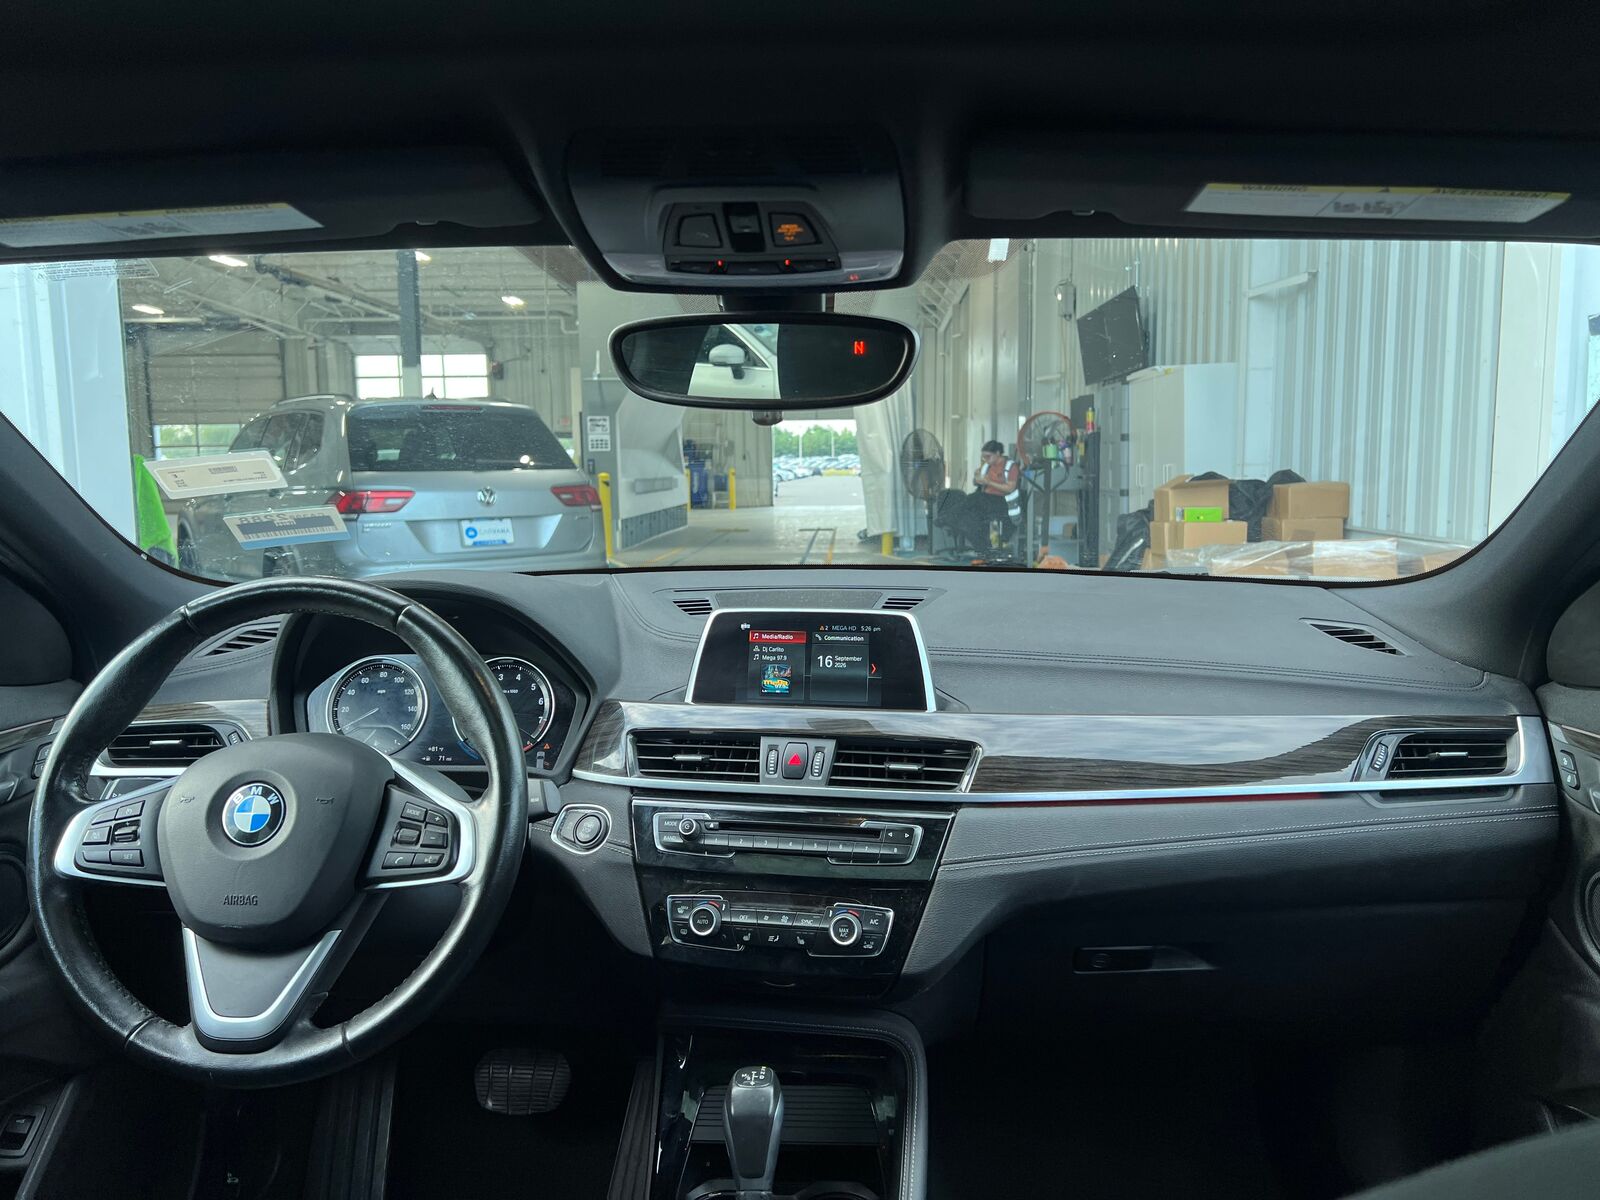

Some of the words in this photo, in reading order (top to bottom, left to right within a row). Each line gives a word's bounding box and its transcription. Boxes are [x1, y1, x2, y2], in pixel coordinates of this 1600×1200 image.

[854, 341, 865, 354] N
[823, 634, 865, 642] Communication
[817, 655, 833, 668] 16
[531, 683, 537, 691] 5
[538, 698, 544, 706] 6
[538, 716, 543, 724] 7
[232, 786, 280, 805] BMW
[407, 808, 420, 816] MODE
[223, 895, 258, 906] AIRBAG
